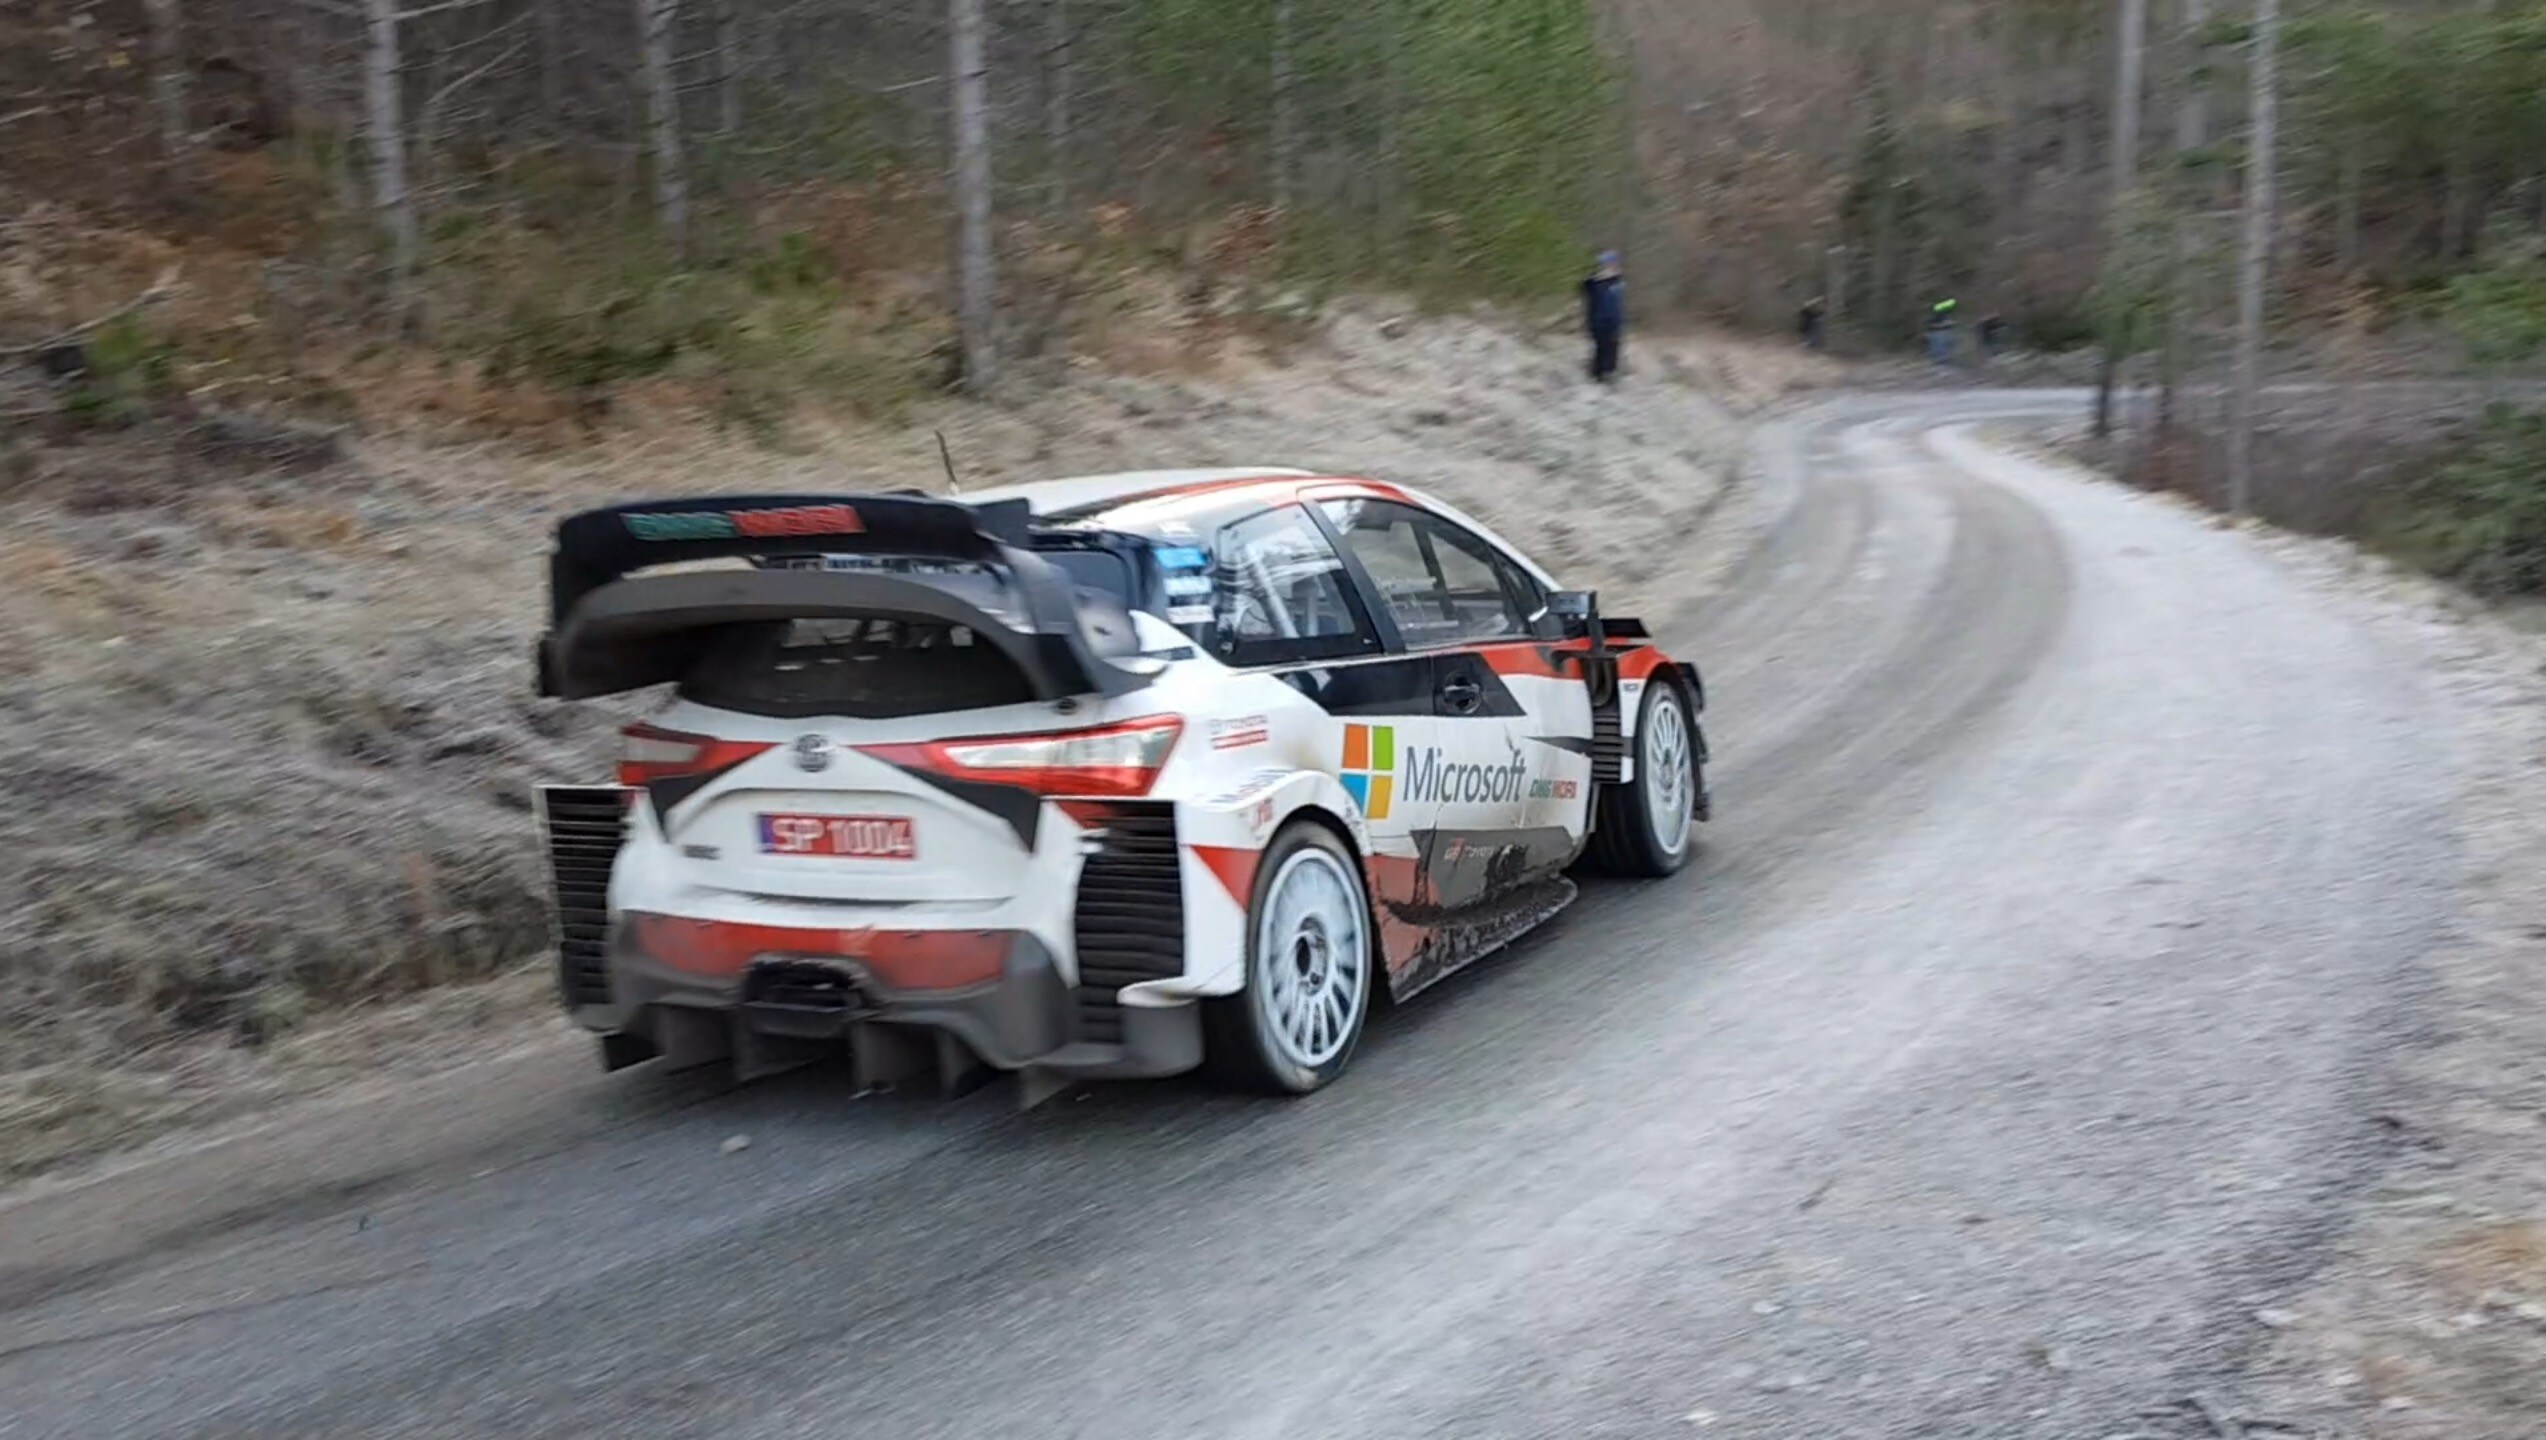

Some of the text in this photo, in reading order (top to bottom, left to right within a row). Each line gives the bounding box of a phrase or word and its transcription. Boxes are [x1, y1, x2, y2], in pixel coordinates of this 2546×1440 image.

[1403, 745, 1527, 804] Microsoft
[772, 818, 914, 855] SP 1004
